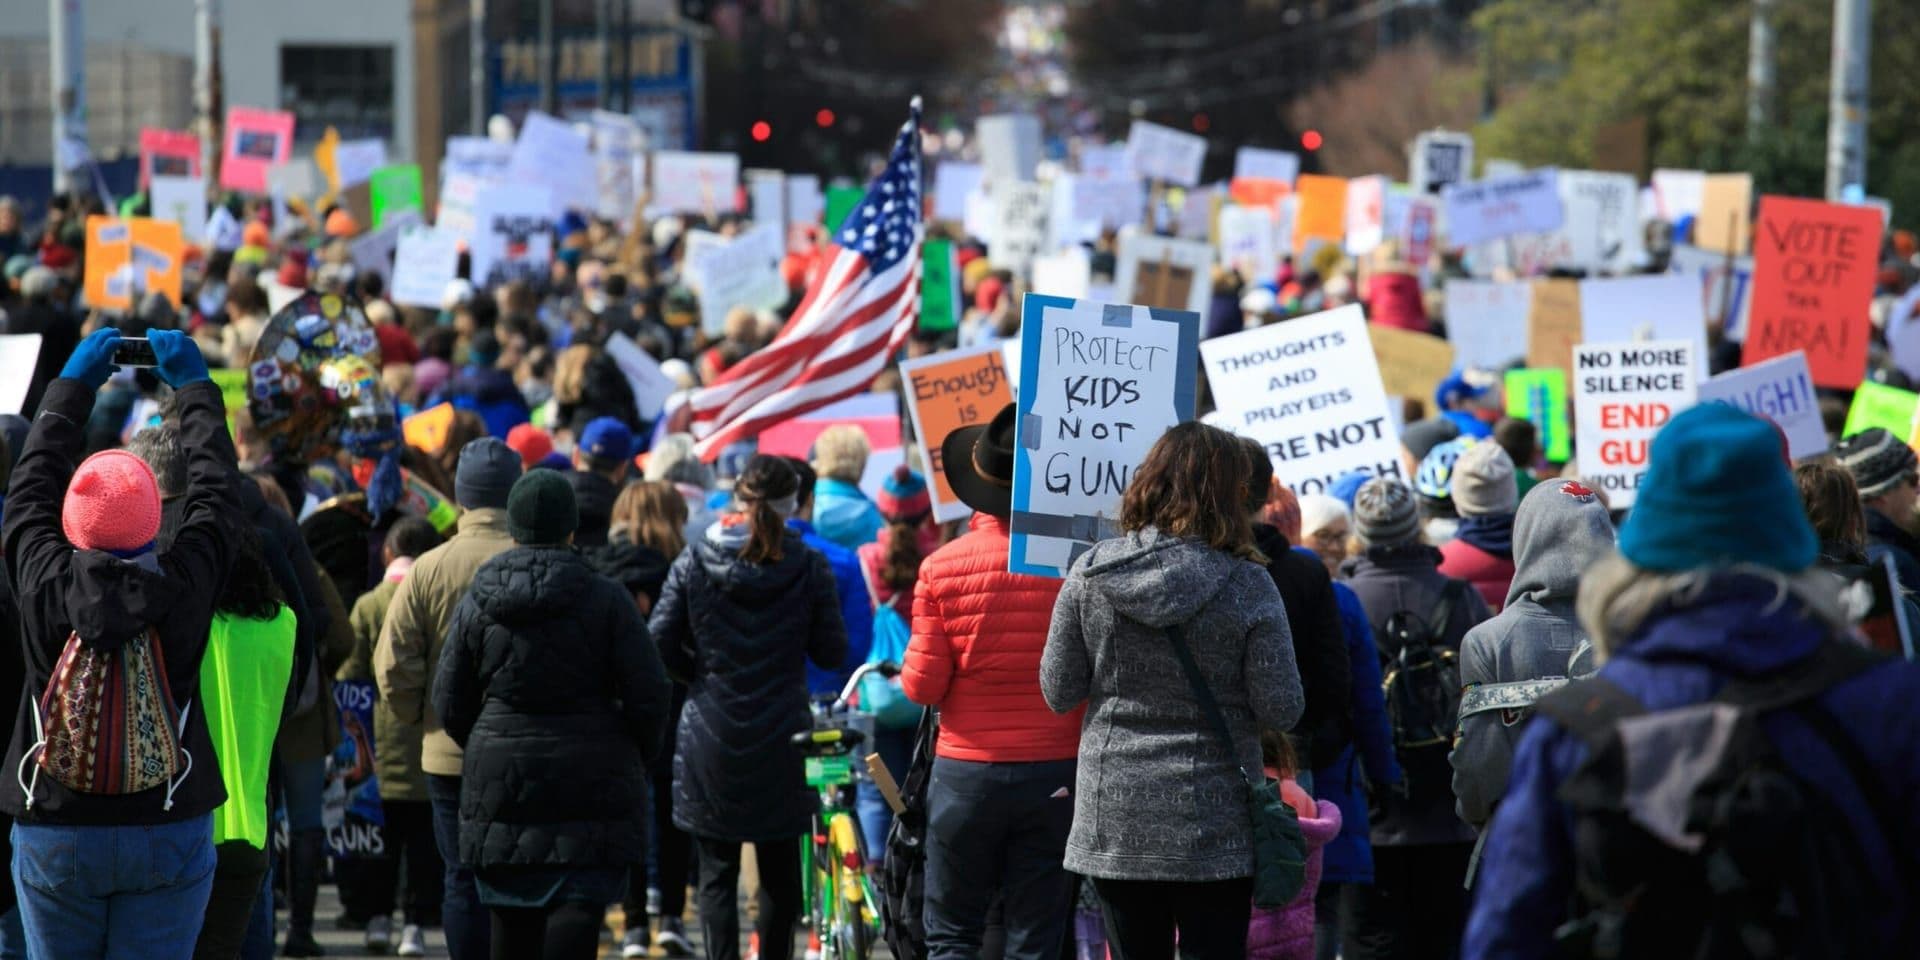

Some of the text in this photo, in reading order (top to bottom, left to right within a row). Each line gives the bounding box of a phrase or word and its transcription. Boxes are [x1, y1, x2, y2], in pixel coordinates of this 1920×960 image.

[1766, 218, 1861, 259] VOTE
[1782, 257, 1849, 288] OUT
[1055, 327, 1168, 372] PROTECT
[1217, 331, 1346, 373] THOUGHTS
[1760, 317, 1850, 361] NRA!
[912, 352, 1007, 400] Enough
[1579, 349, 1688, 369] NO MORE
[1064, 375, 1140, 413] KIDS
[1267, 367, 1317, 391] AND
[1585, 374, 1684, 394] SILENCE
[956, 396, 977, 423] is
[1244, 387, 1353, 425] PRAYERS
[1600, 403, 1671, 429] END
[1058, 416, 1135, 442] NOT
[1264, 416, 1385, 461] RE NOT
[1600, 440, 1652, 466] GU
[1046, 452, 1140, 496] GUN
[327, 823, 384, 855] GUNS
